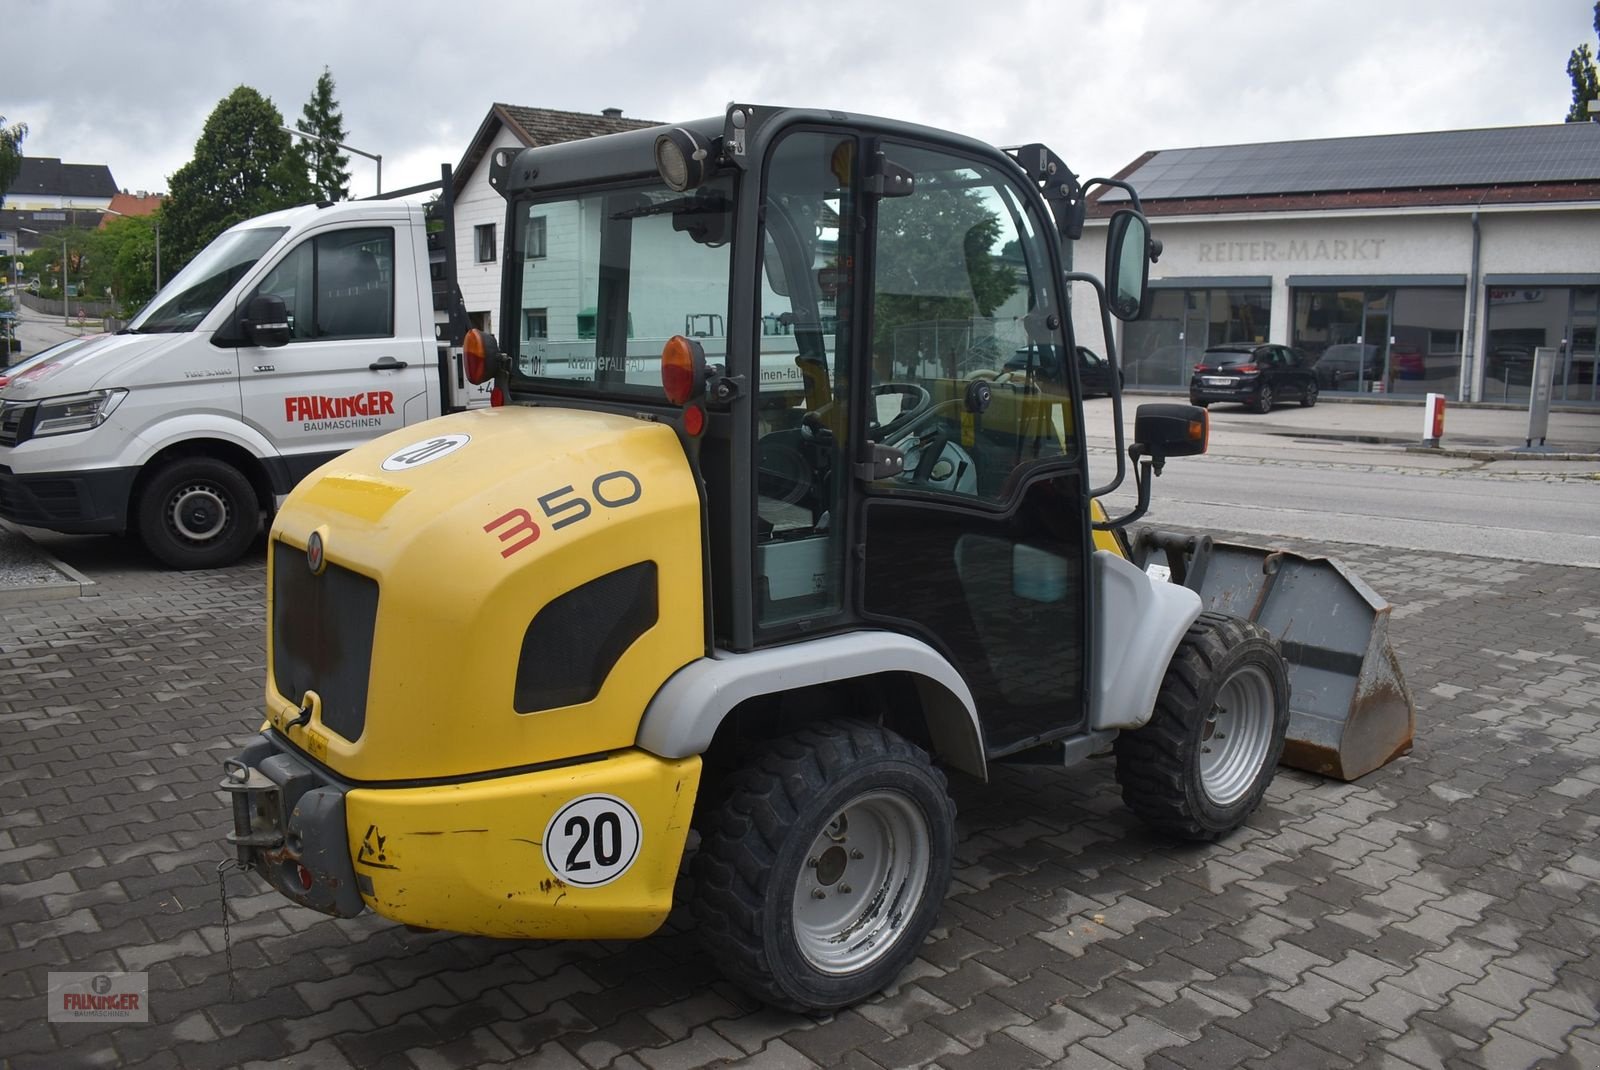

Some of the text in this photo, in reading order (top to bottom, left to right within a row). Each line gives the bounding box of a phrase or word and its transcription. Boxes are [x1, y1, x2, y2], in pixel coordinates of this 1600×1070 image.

[285, 391, 395, 422] FALKINGER
[303, 418, 382, 431] BAUMASCHINEN
[392, 438, 458, 464] 20
[483, 470, 642, 559] 350
[564, 811, 622, 872] 20
